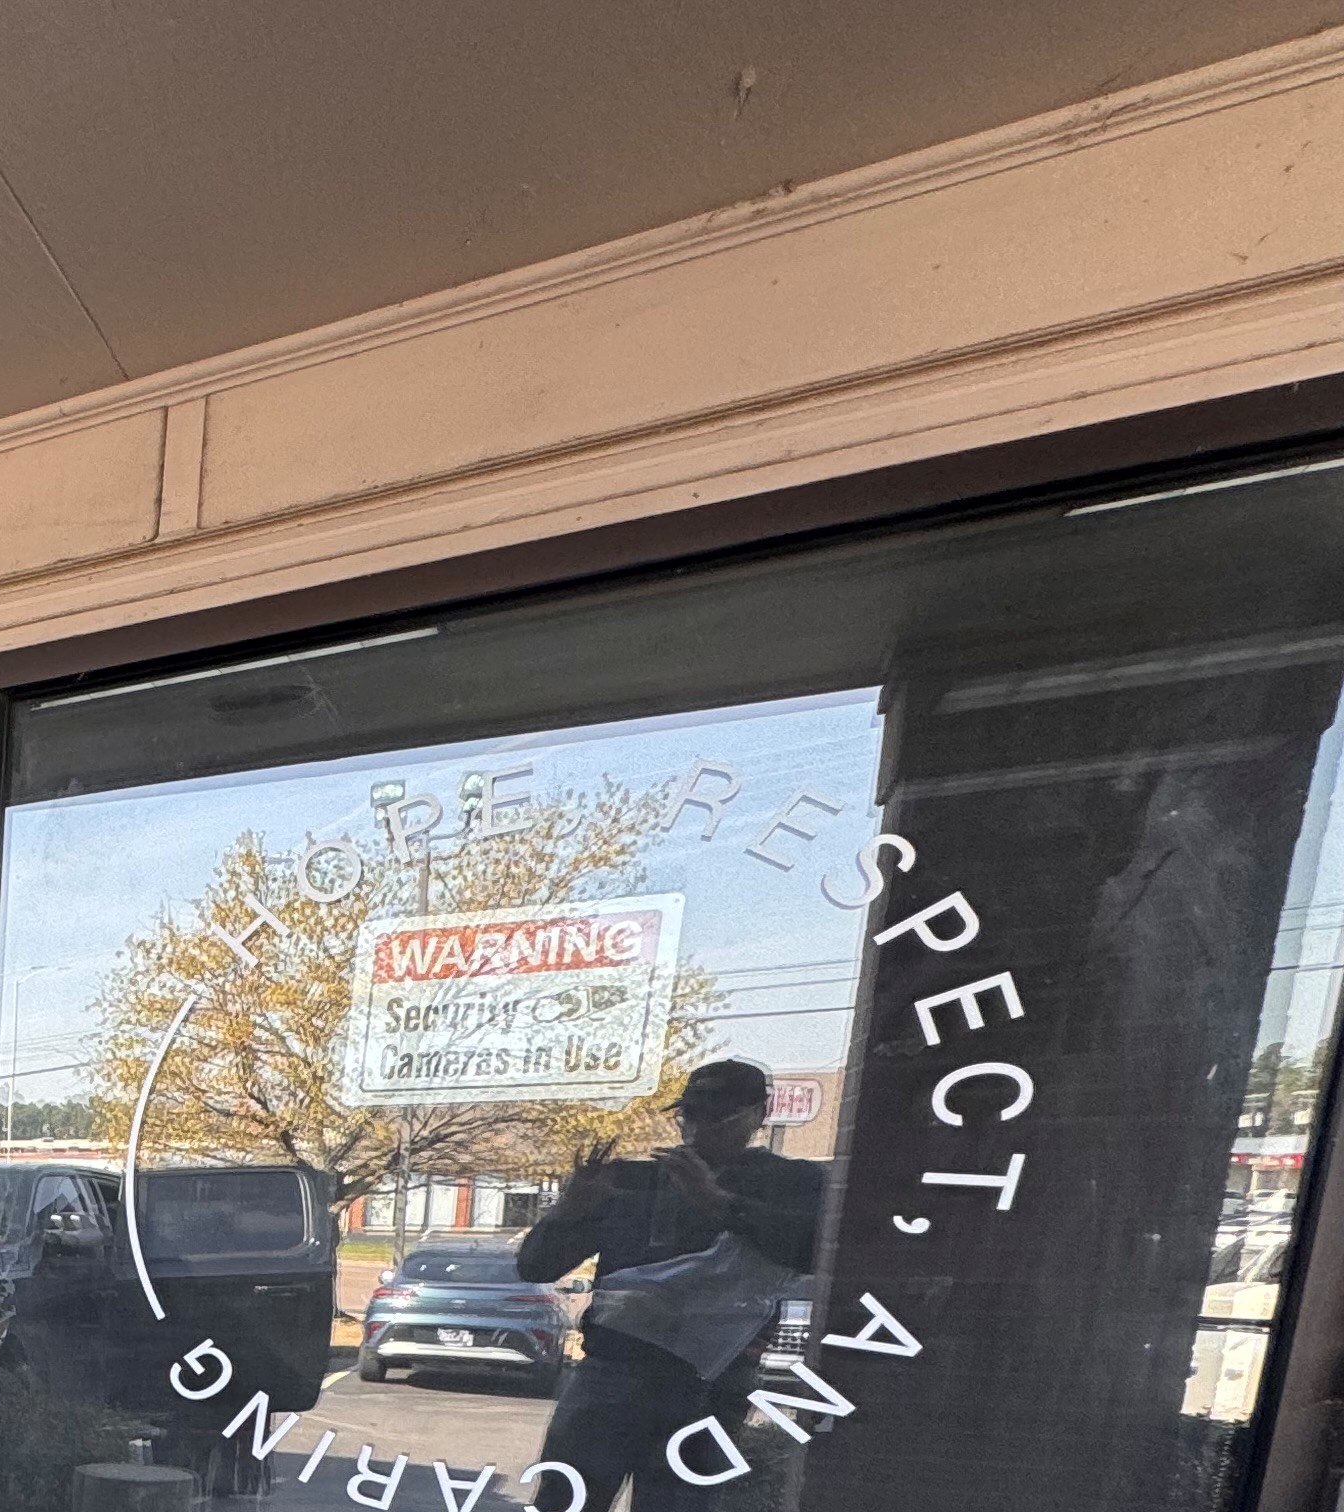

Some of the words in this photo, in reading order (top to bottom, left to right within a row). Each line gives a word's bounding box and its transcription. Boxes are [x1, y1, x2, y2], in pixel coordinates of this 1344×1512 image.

[391, 919, 643, 977] WARNING
[385, 991, 518, 1034] Security
[662, 757, 1034, 1234] RESPECT,
[381, 1041, 512, 1081] Cameras
[522, 1043, 552, 1074] in
[564, 1034, 622, 1072] Use
[667, 1292, 923, 1486] AND
